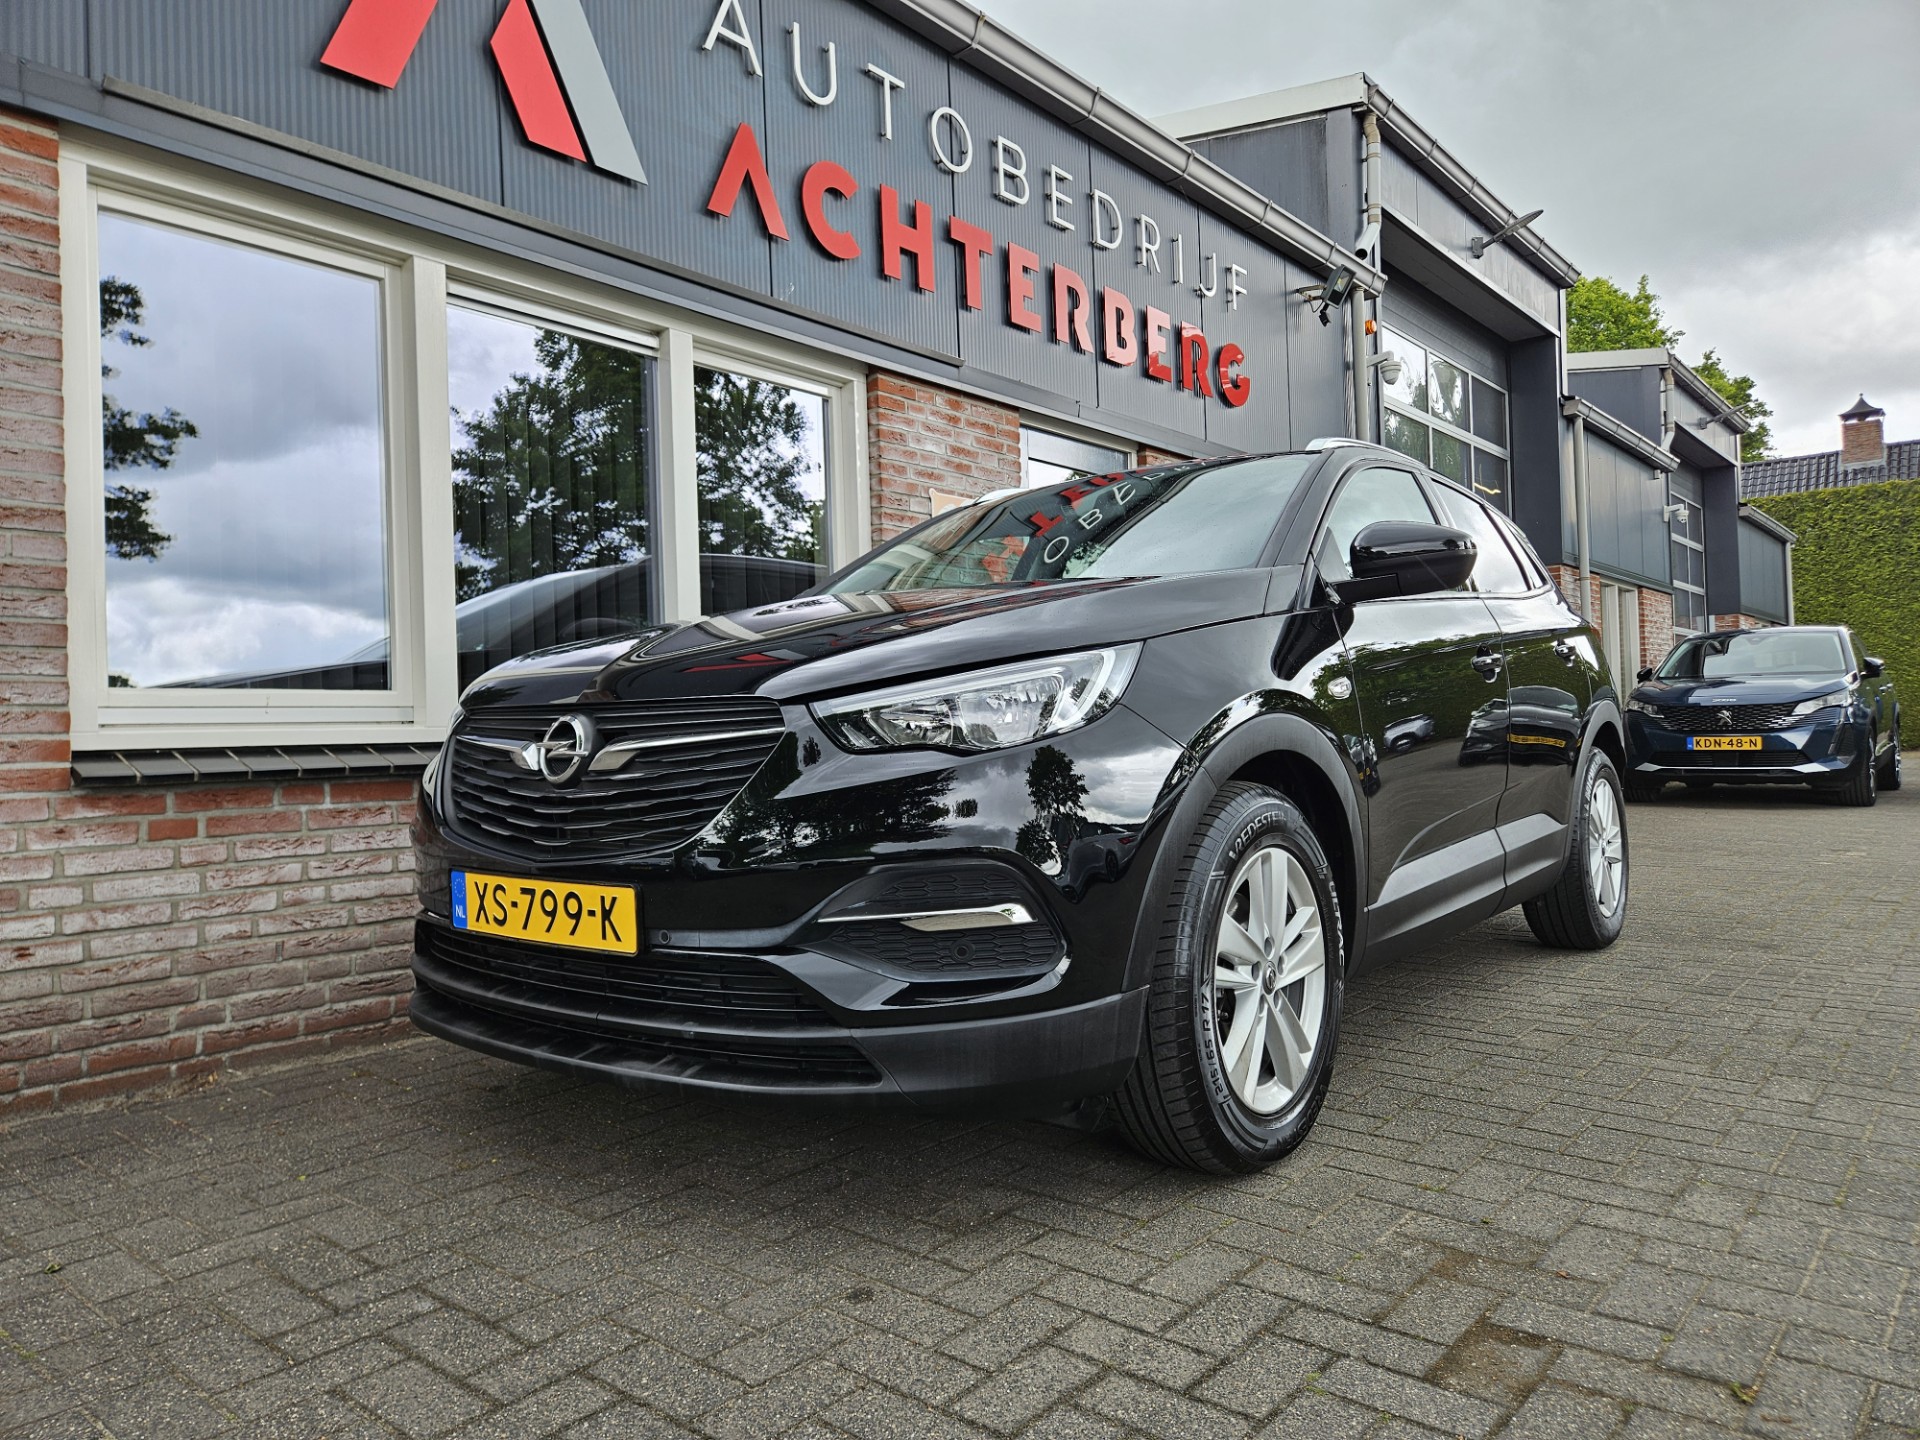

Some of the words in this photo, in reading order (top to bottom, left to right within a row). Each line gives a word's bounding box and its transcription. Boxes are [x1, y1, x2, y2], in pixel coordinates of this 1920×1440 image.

[701, 0, 1249, 312] AUTOBEDRIJF
[707, 121, 1252, 409] ACHTERBERG
[1695, 738, 1758, 748] KDN-48-N
[1228, 811, 1287, 860] VREDESTEIN
[455, 904, 466, 919] NL
[474, 881, 622, 942] XS-799-K
[1328, 880, 1345, 967] ULTRAC
[1204, 1039, 1224, 1096] 215/65
